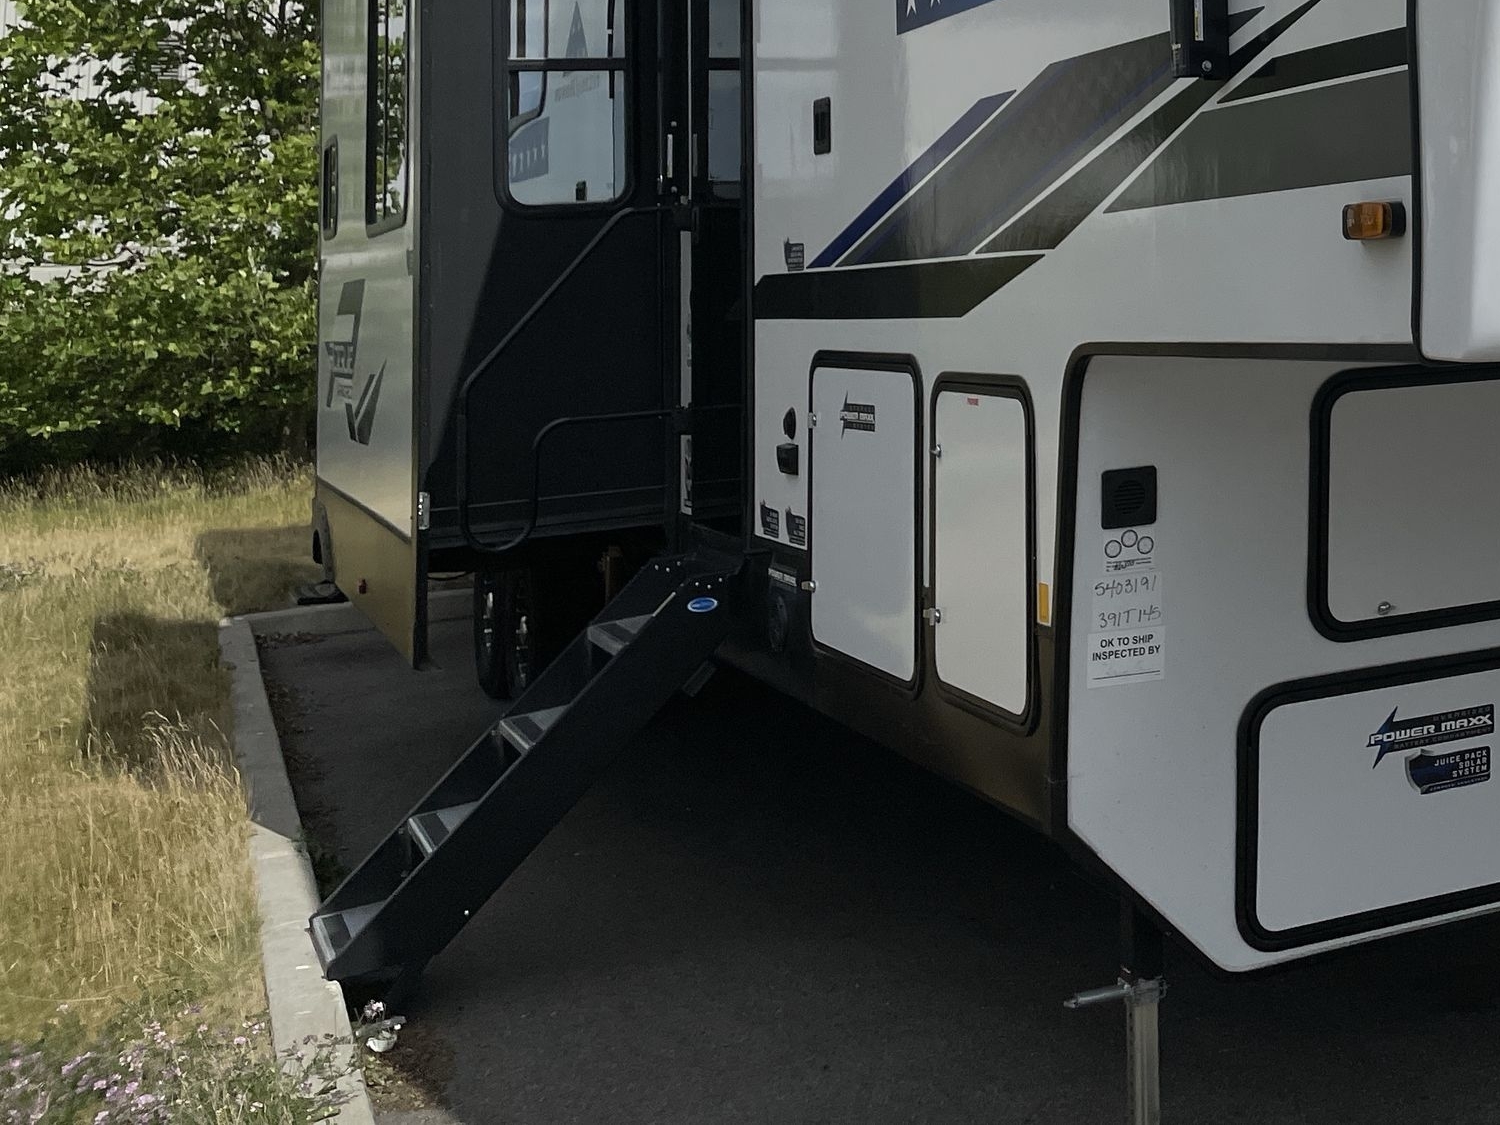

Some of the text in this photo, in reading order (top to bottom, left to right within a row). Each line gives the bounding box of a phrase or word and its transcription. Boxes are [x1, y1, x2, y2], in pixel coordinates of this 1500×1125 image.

[1100, 634, 1153, 648] OK TO SHIP
[1092, 645, 1160, 661] INSPECTED BY
[1370, 714, 1493, 745] POWER MAXX
[1434, 750, 1487, 767] JUICE PACK
[1459, 756, 1487, 768] SOLAR
[1452, 764, 1487, 777] SYSTEM
